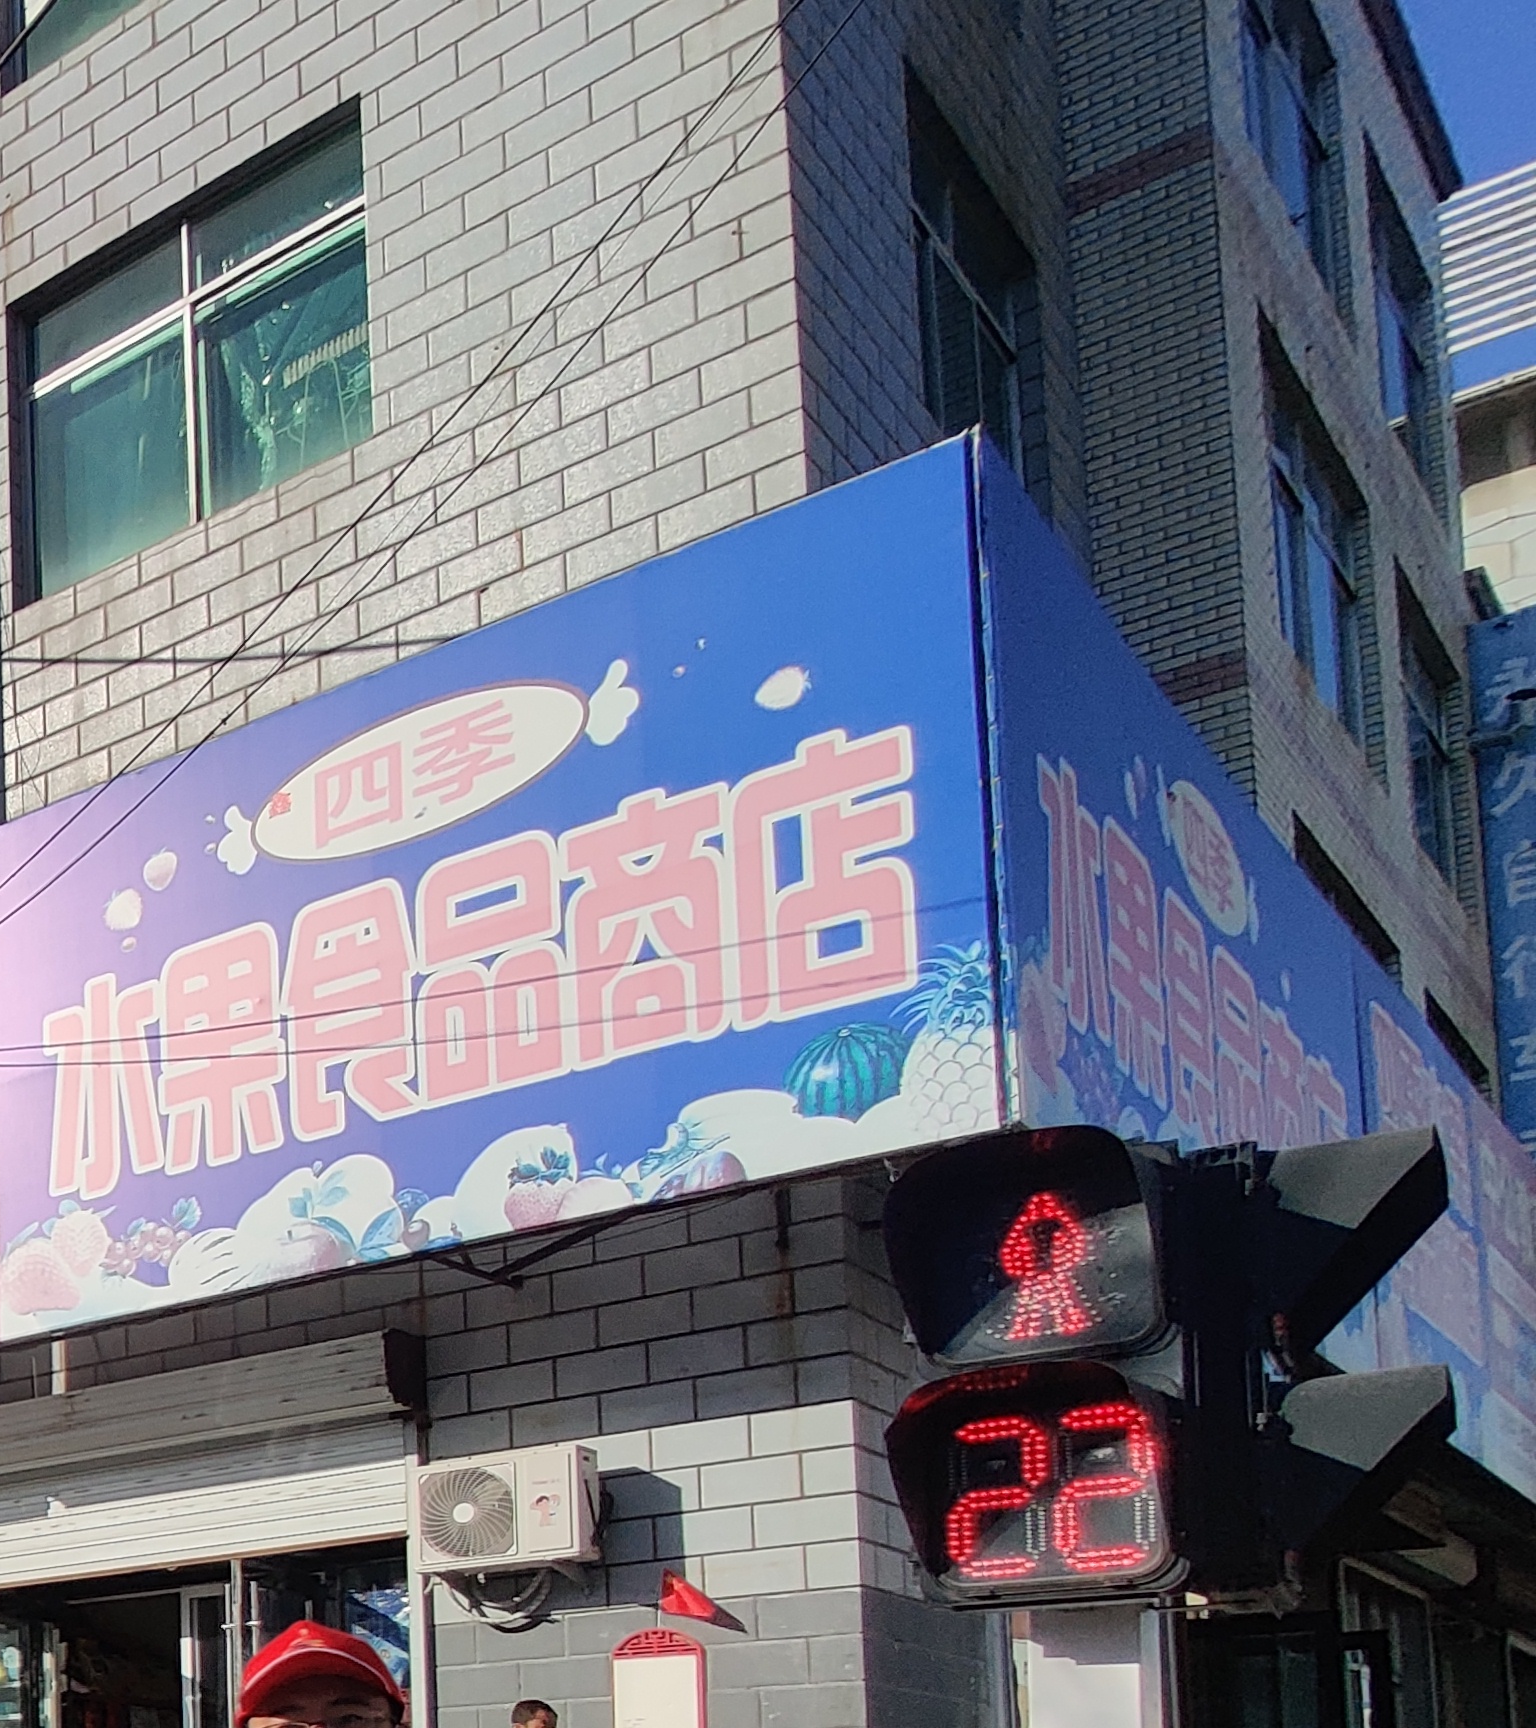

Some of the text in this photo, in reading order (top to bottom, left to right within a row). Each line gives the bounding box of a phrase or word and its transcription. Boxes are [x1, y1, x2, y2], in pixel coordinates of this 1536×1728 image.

[315, 699, 515, 849] 四季
[45, 726, 915, 1198] 水果食品商店
[944, 1402, 1160, 1579] 22
